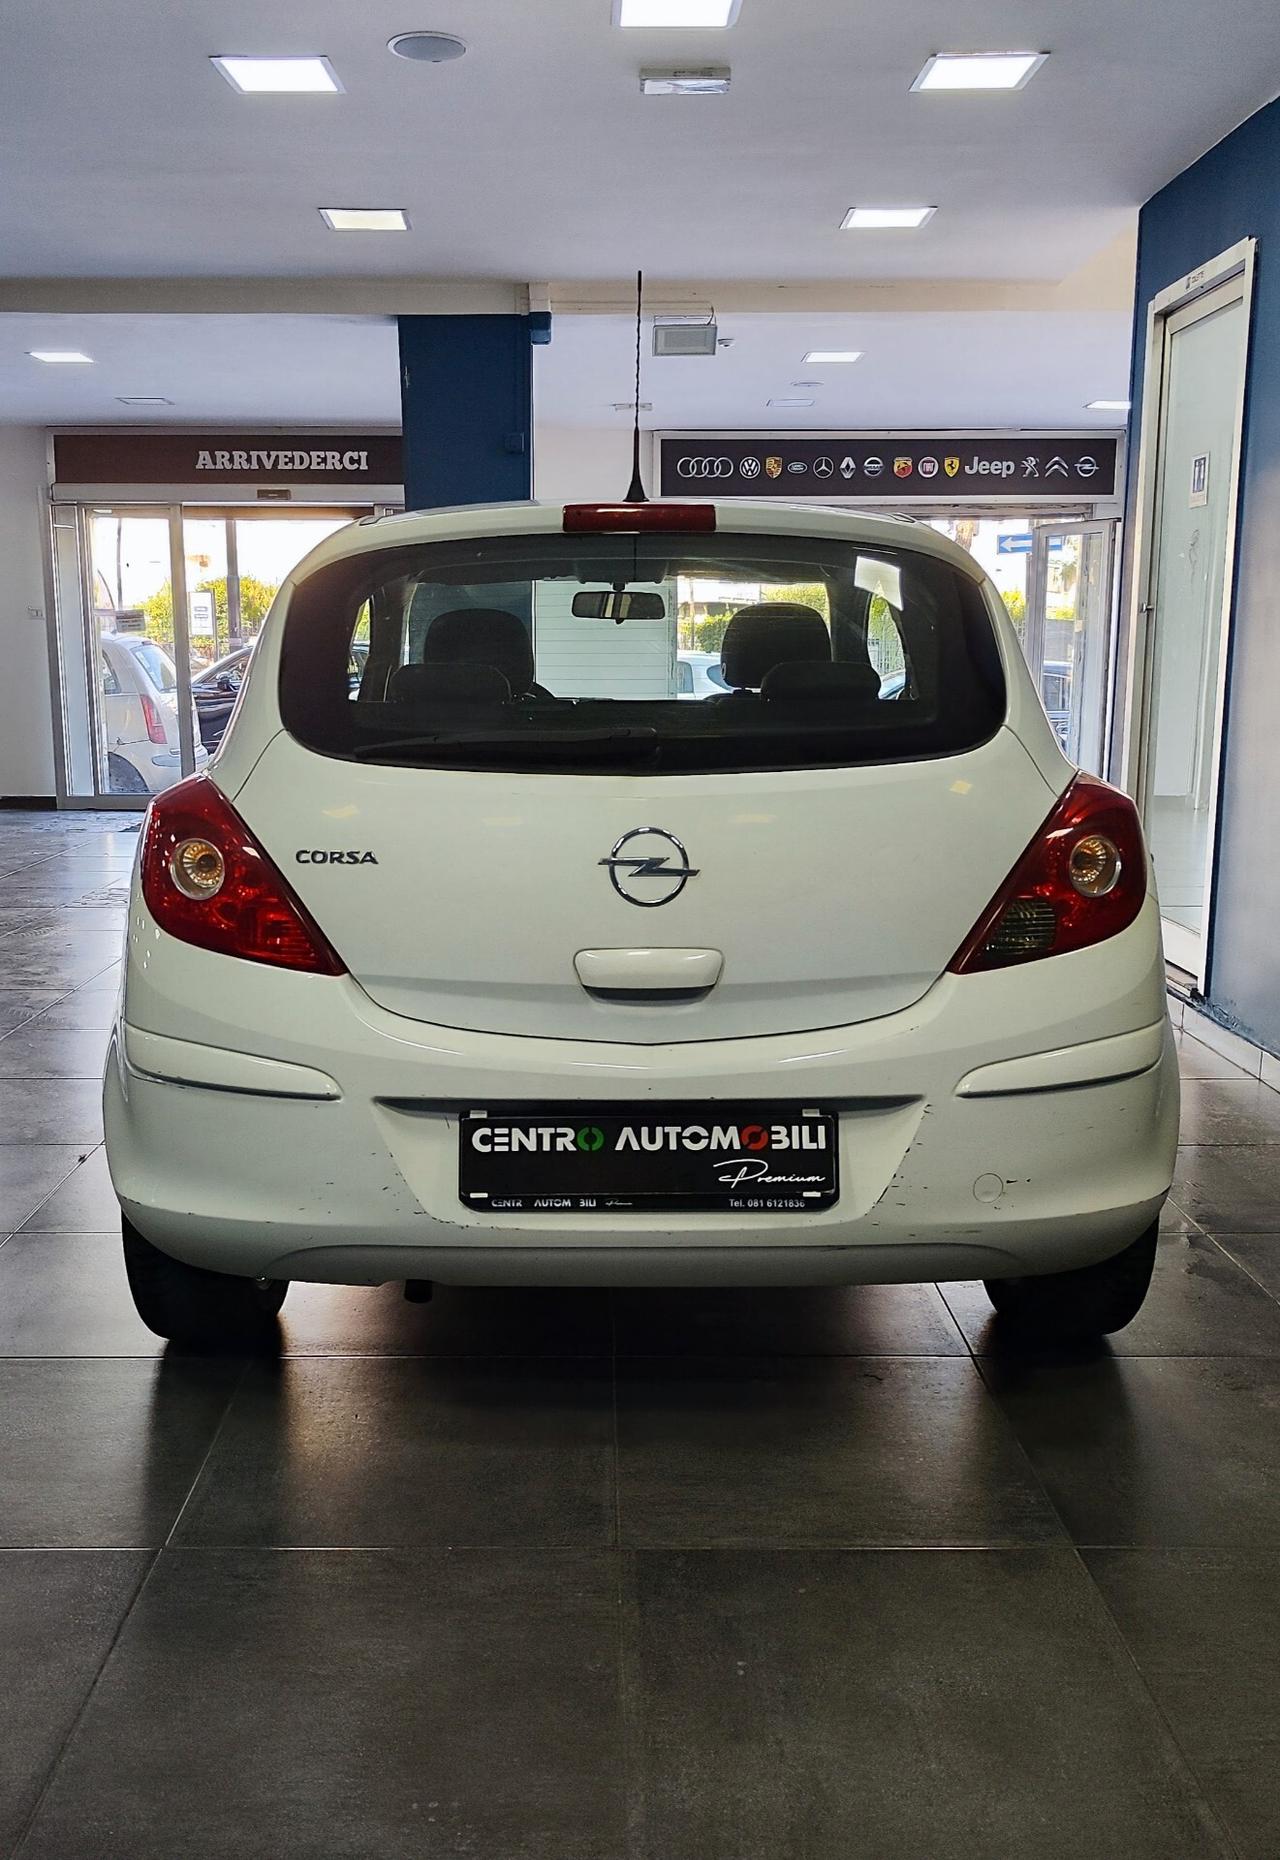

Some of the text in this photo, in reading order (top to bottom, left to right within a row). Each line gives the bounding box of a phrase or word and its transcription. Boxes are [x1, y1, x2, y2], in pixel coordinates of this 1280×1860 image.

[196, 450, 368, 470] ARRIVEDERCI
[964, 456, 1015, 478] Jeep
[295, 850, 379, 864] CORSA
[471, 1125, 827, 1152] CENTRO AUTOMOBILI
[712, 1158, 827, 1189] Premium
[728, 1198, 746, 1208] Tel.
[747, 1198, 764, 1208] 081
